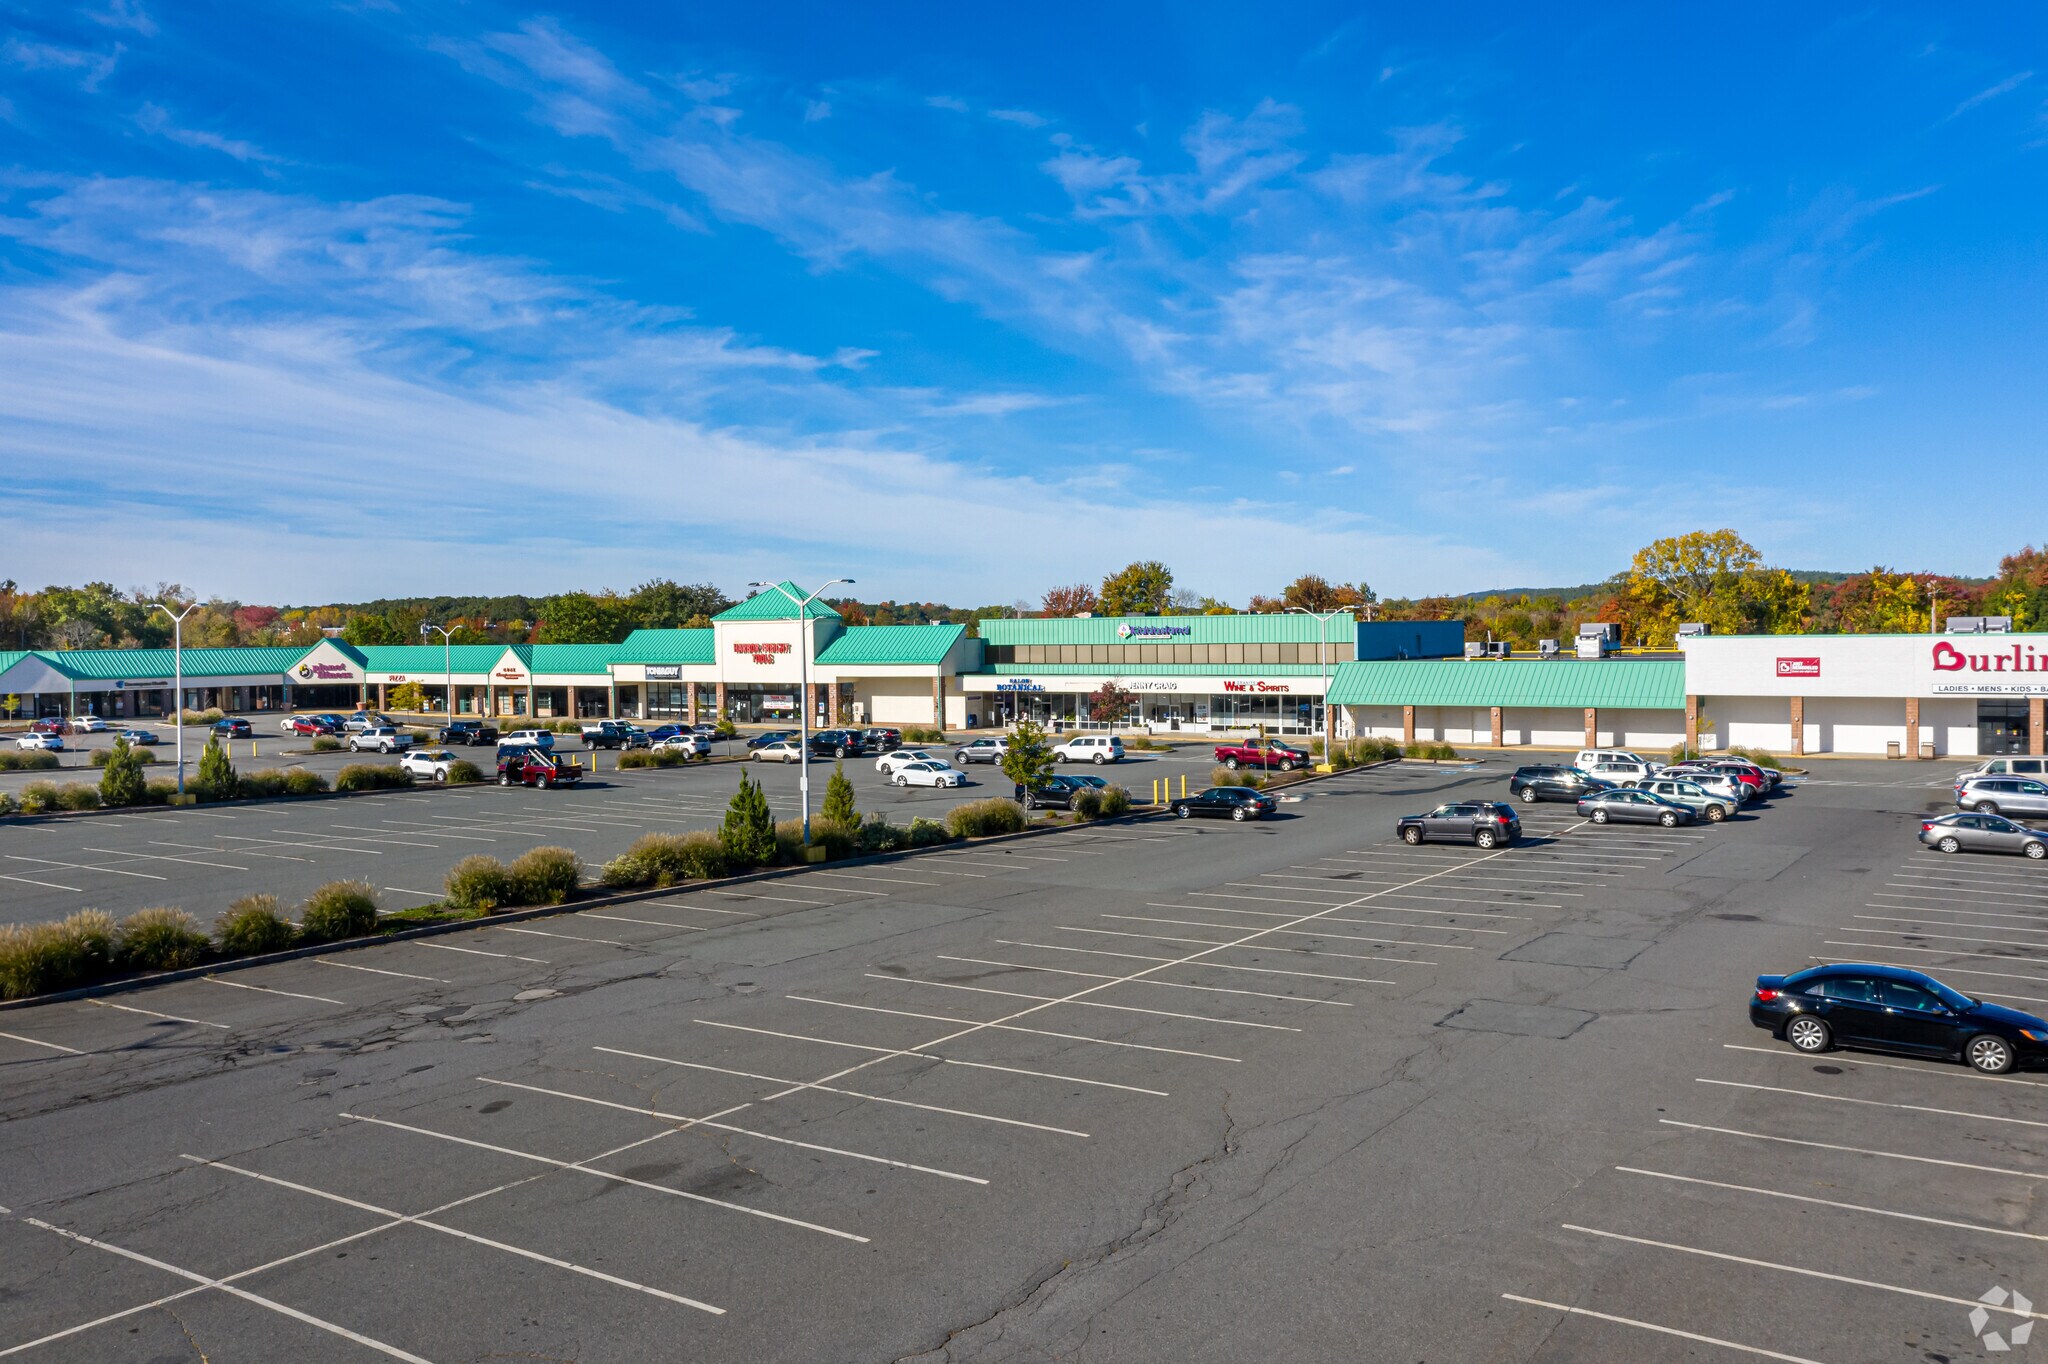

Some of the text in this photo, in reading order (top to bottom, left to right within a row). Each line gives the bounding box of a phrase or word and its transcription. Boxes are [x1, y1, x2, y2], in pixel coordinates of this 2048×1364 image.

[1129, 681, 1178, 690] JENNY CRAIG
[1249, 684, 1255, 692] &
